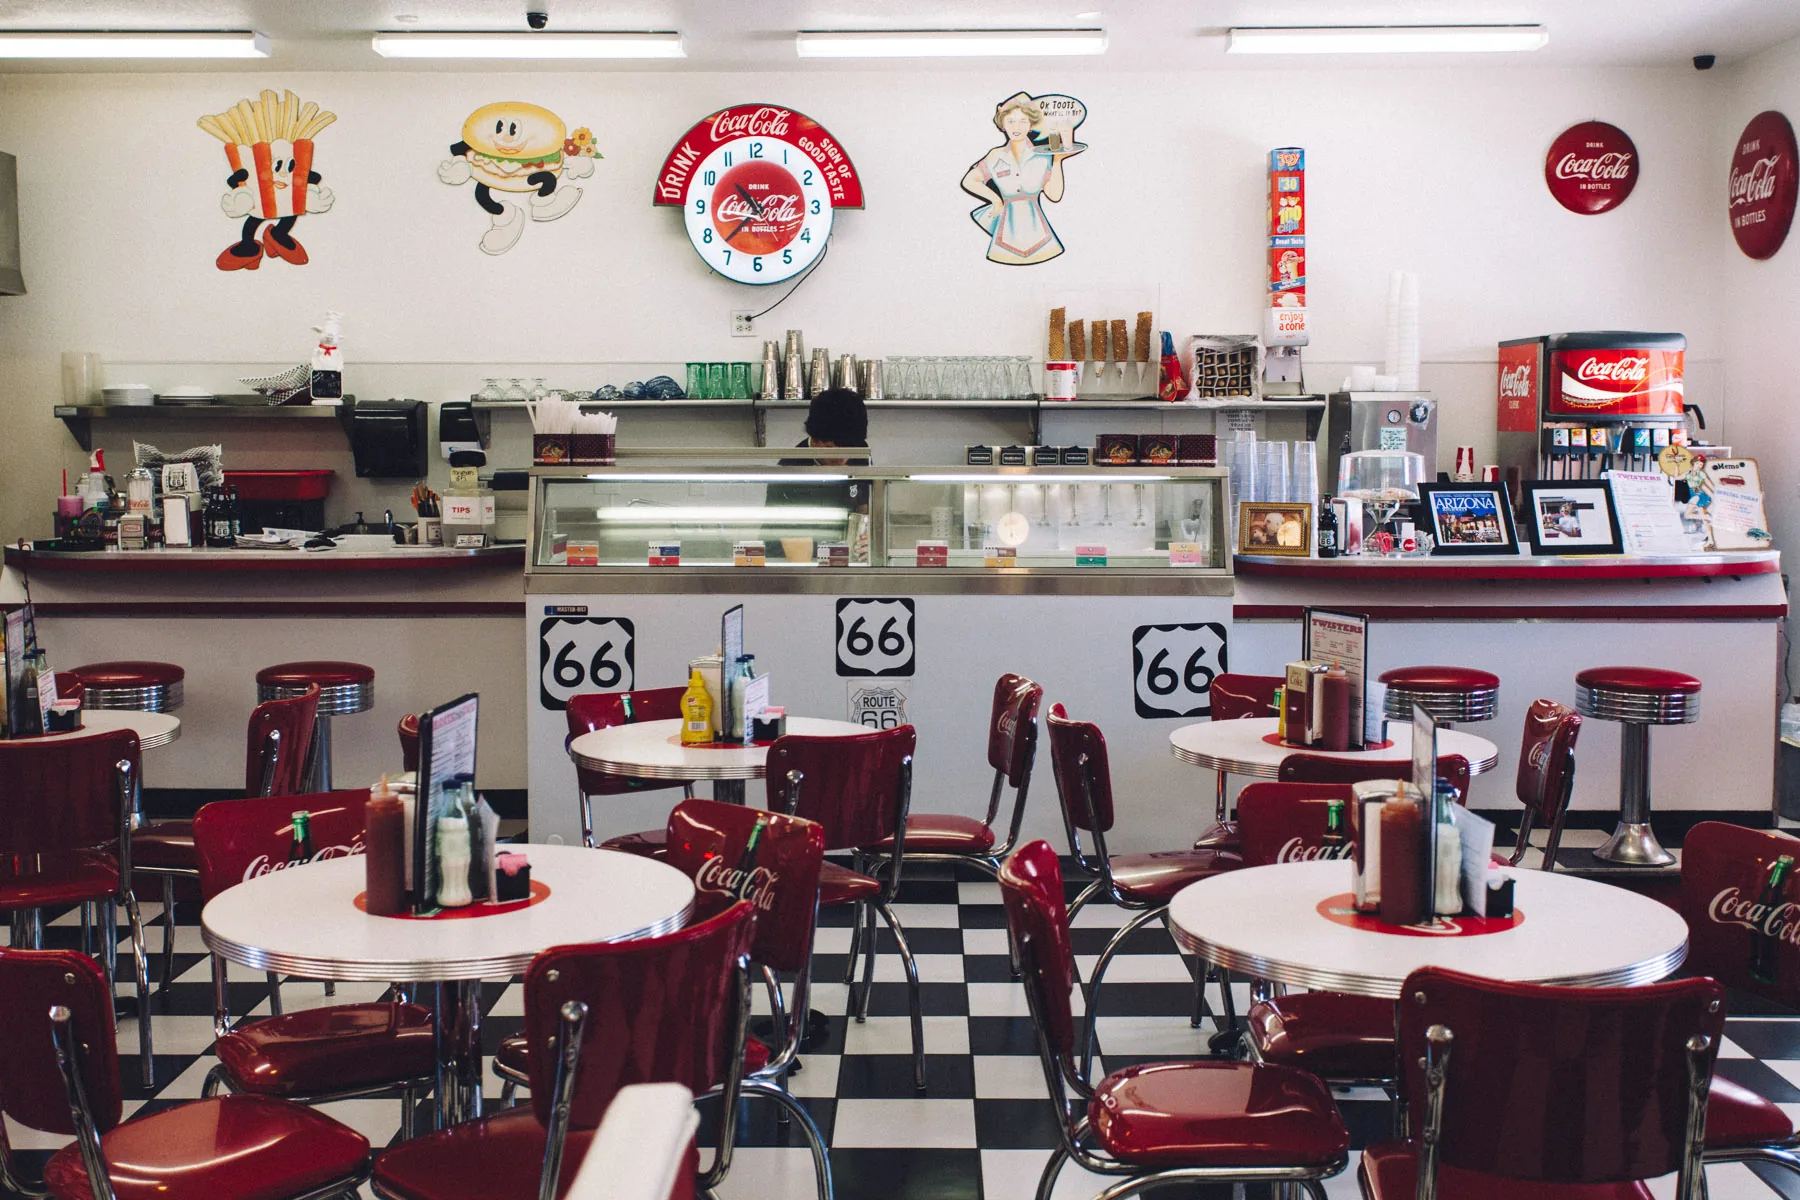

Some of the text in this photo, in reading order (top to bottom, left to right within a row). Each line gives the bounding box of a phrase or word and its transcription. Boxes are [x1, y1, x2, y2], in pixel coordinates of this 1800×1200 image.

[1040, 100, 1075, 109] OK TOOTS
[710, 107, 791, 142] Coca-Cola
[750, 143, 763, 158] 12
[1742, 139, 1760, 155] DRINK
[724, 152, 732, 166] 11
[784, 149, 788, 164] 1
[820, 138, 852, 178] SIGN OF
[658, 142, 701, 199] DRINK
[798, 136, 845, 201] GOOD TASTE
[1556, 152, 1632, 180] Coca-Cola
[704, 170, 716, 186] 10
[804, 170, 812, 185] 2
[1729, 154, 1782, 208] Coca-Cola
[696, 200, 705, 214] 9
[811, 200, 820, 214] 3
[1734, 210, 1766, 228] IN BOTTLES
[703, 228, 712, 243] 8
[800, 229, 811, 244] 4
[723, 250, 732, 266] 7
[753, 256, 762, 272] 6
[783, 250, 792, 264] 5
[1280, 312, 1304, 322] enjoy
[1286, 322, 1306, 330] cone
[1578, 357, 1650, 381] Coca-Cola
[1500, 365, 1530, 398] Coca-Cola
[1616, 473, 1662, 481] TWISTERS
[1436, 498, 1496, 509] ARIZONA
[1312, 618, 1363, 634] TWISTERS
[847, 616, 905, 656] 66
[554, 640, 622, 688] 66
[1147, 646, 1215, 695] 66
[863, 696, 896, 708] ROUTE
[862, 710, 898, 730] 66
[695, 854, 779, 911] Coca-Cola
